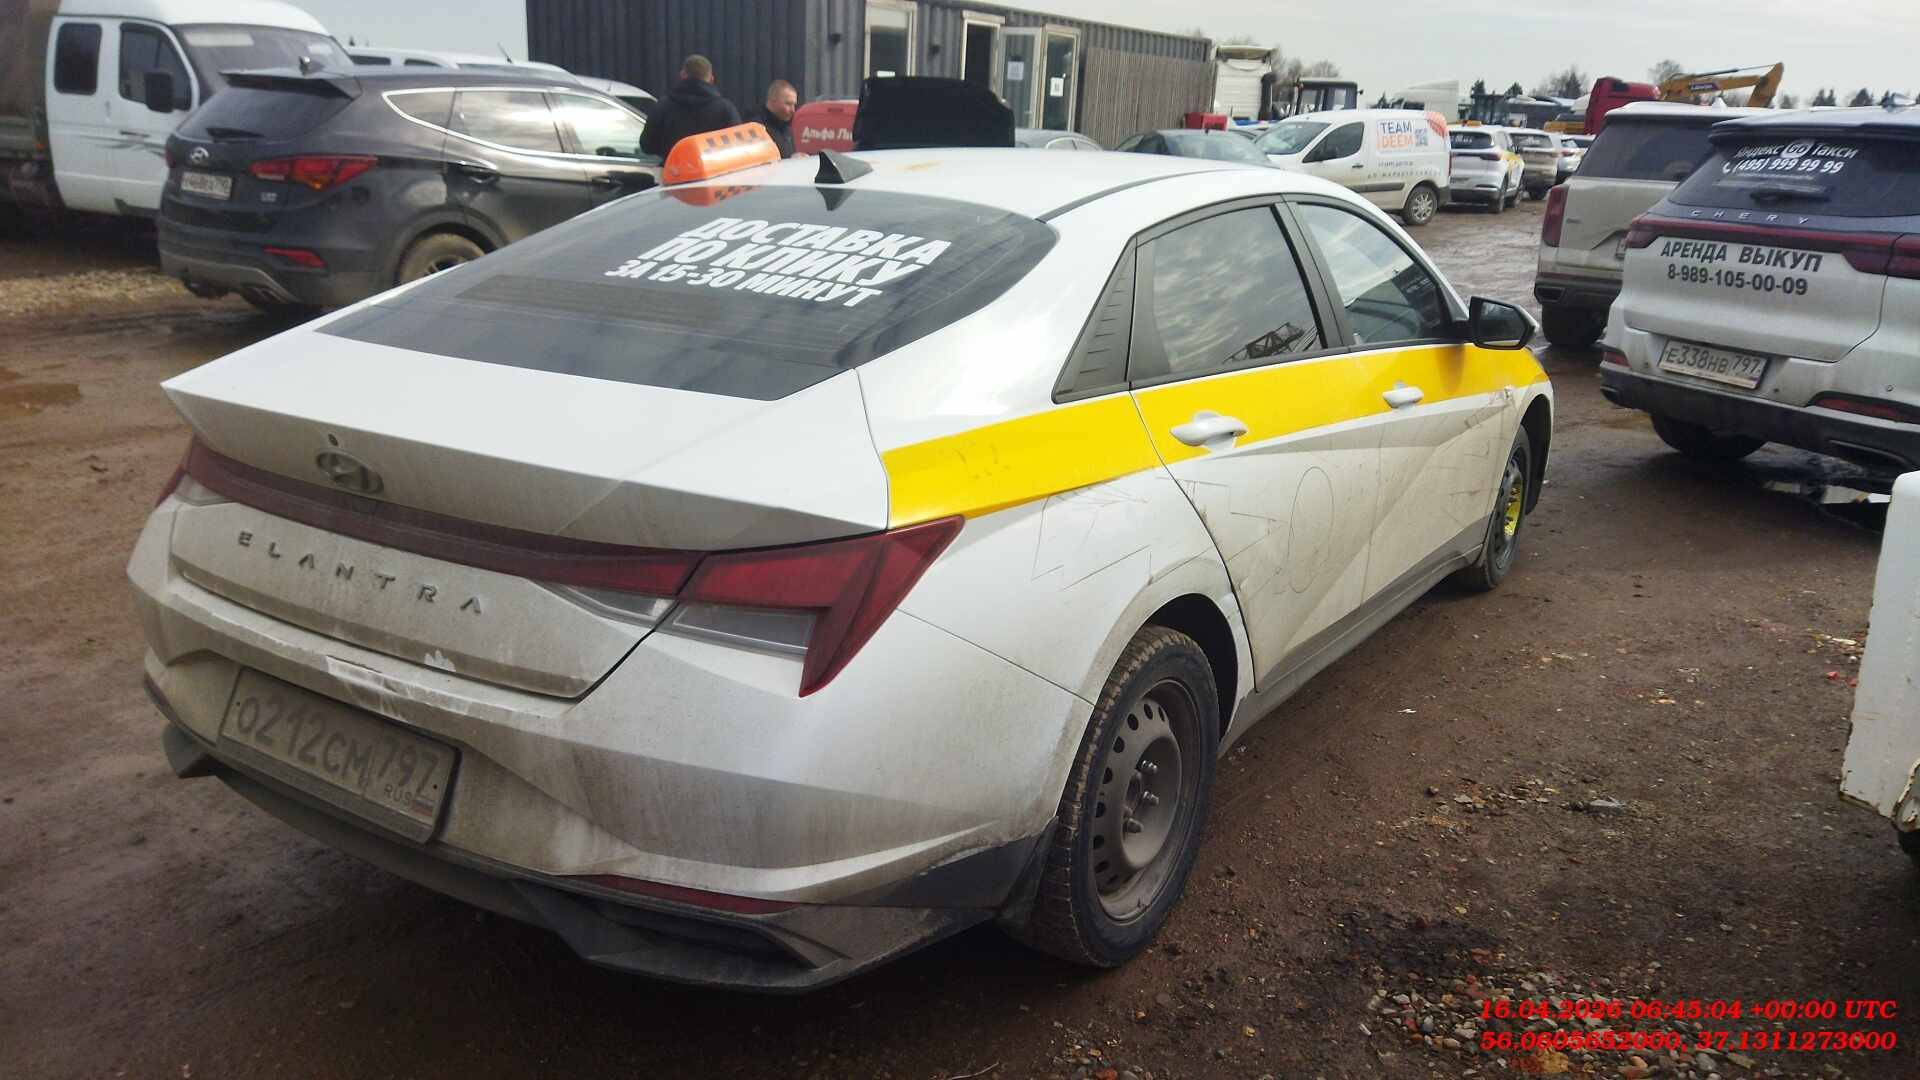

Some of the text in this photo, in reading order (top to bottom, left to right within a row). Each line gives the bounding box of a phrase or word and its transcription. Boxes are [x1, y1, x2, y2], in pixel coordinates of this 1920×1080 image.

[1380, 121, 1412, 134] TEAM
[1382, 134, 1414, 148] DEEM
[1809, 143, 1859, 158] Такси
[1732, 158, 1845, 173] (495) 999 99 99
[1690, 208, 1809, 225] CHERY
[678, 217, 952, 265] ДОСТАВКА
[638, 237, 925, 287] ПО КЛИКУ
[1660, 240, 1823, 273] АРЕНДА ВЫКУП
[604, 259, 883, 308] ЗА 15-30 МИНУТ
[1667, 263, 1809, 296] 8-989-105-00-09
[237, 530, 482, 615] ELANTRA
[384, 782, 413, 803] RUS
